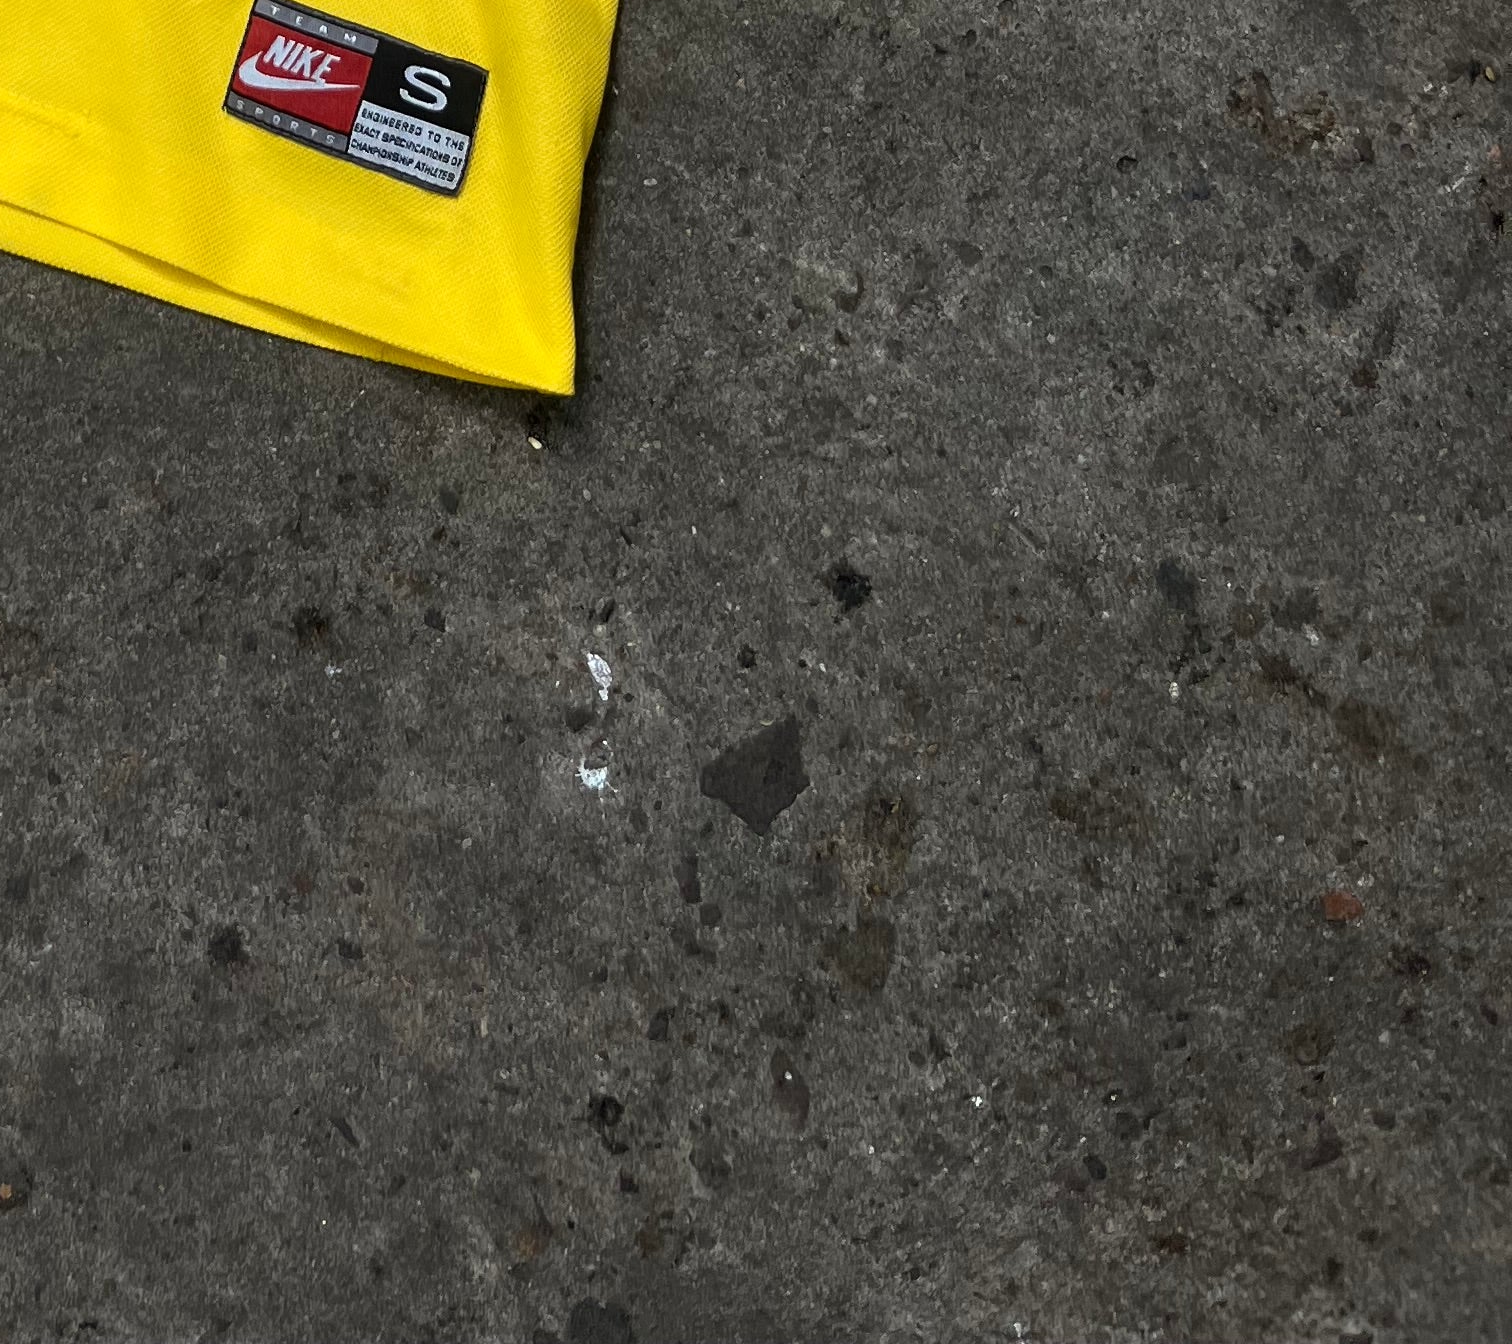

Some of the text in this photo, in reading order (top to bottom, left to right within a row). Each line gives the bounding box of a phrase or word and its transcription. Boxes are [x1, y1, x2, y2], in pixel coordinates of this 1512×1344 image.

[271, 4, 357, 44] TEAM
[264, 35, 341, 83] NIKE
[399, 65, 451, 111] S
[236, 100, 335, 144] SPORTS
[361, 108, 465, 151] ENGINEERED TO THE
[351, 139, 456, 182] CHAMPIONSHIP ATHLETES
[354, 122, 463, 167] EXACT SPECIFICATIONS OF
